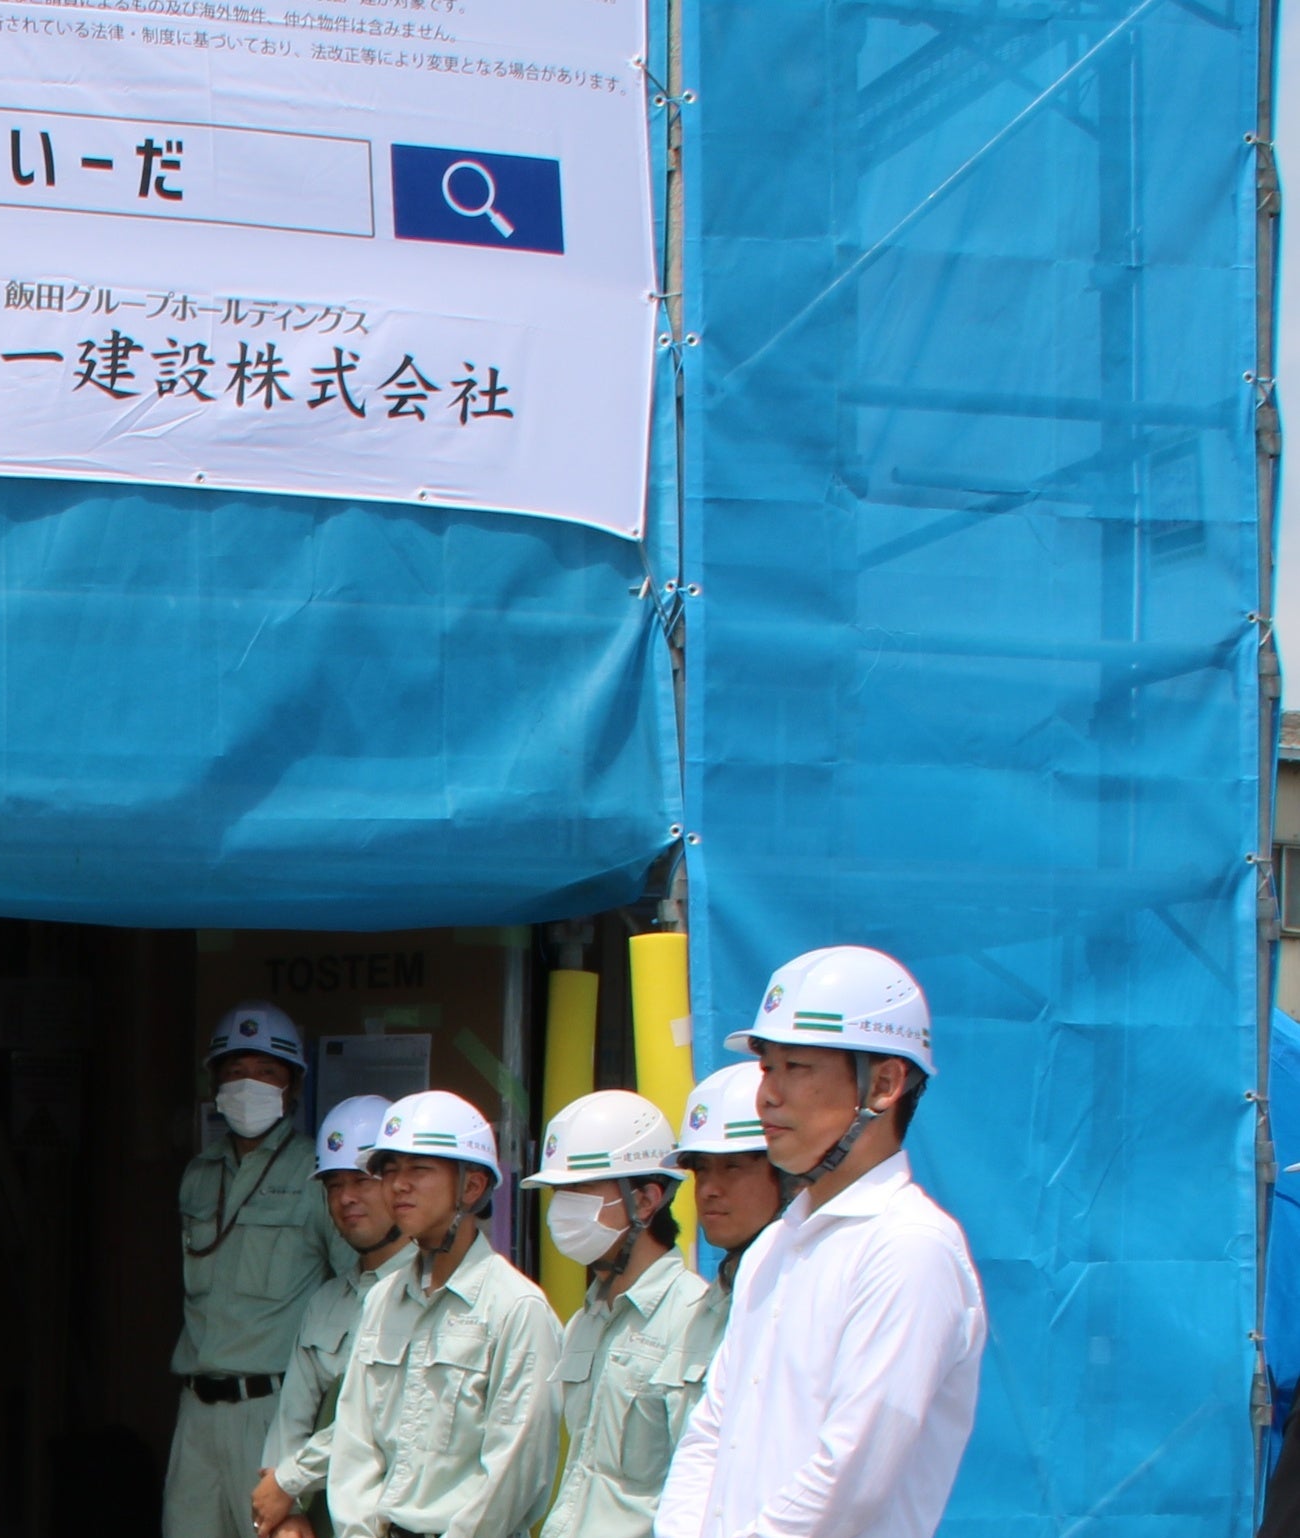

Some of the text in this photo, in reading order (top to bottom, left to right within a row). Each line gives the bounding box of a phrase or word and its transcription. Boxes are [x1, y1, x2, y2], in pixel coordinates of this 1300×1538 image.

[4, 279, 370, 336] 飯田グループホールディングス
[0, 329, 515, 424] 一建設株式会社
[264, 950, 425, 995] TOSTEM
